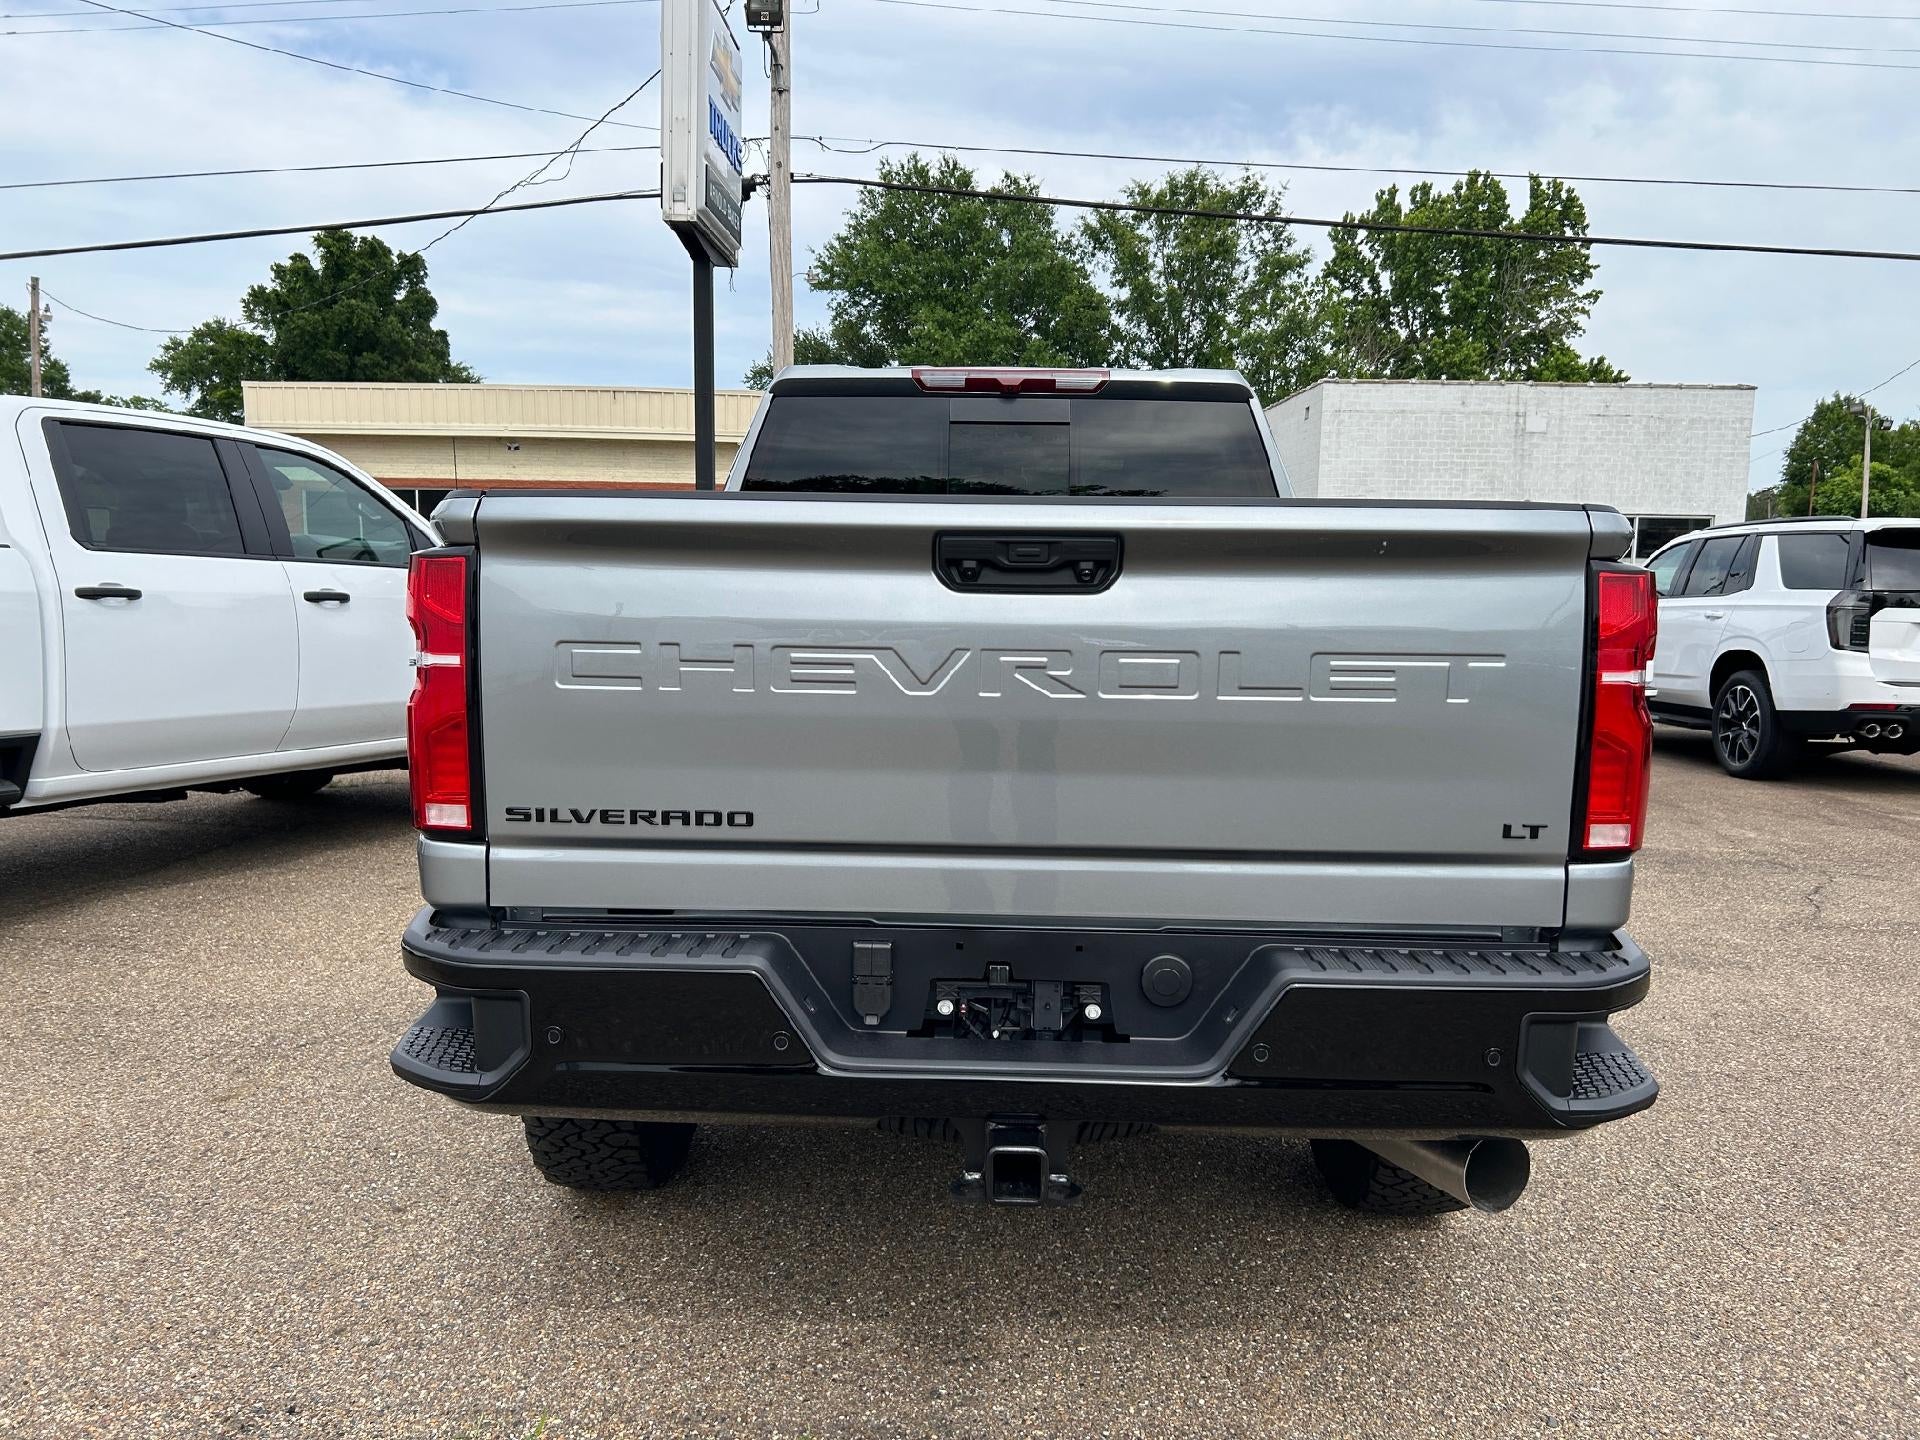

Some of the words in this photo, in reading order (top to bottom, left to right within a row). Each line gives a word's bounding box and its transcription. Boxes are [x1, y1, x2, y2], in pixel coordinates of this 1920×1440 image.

[554, 640, 1507, 704] CHEVROLET
[505, 806, 754, 828] SILVERADO
[1502, 823, 1549, 840] LT
